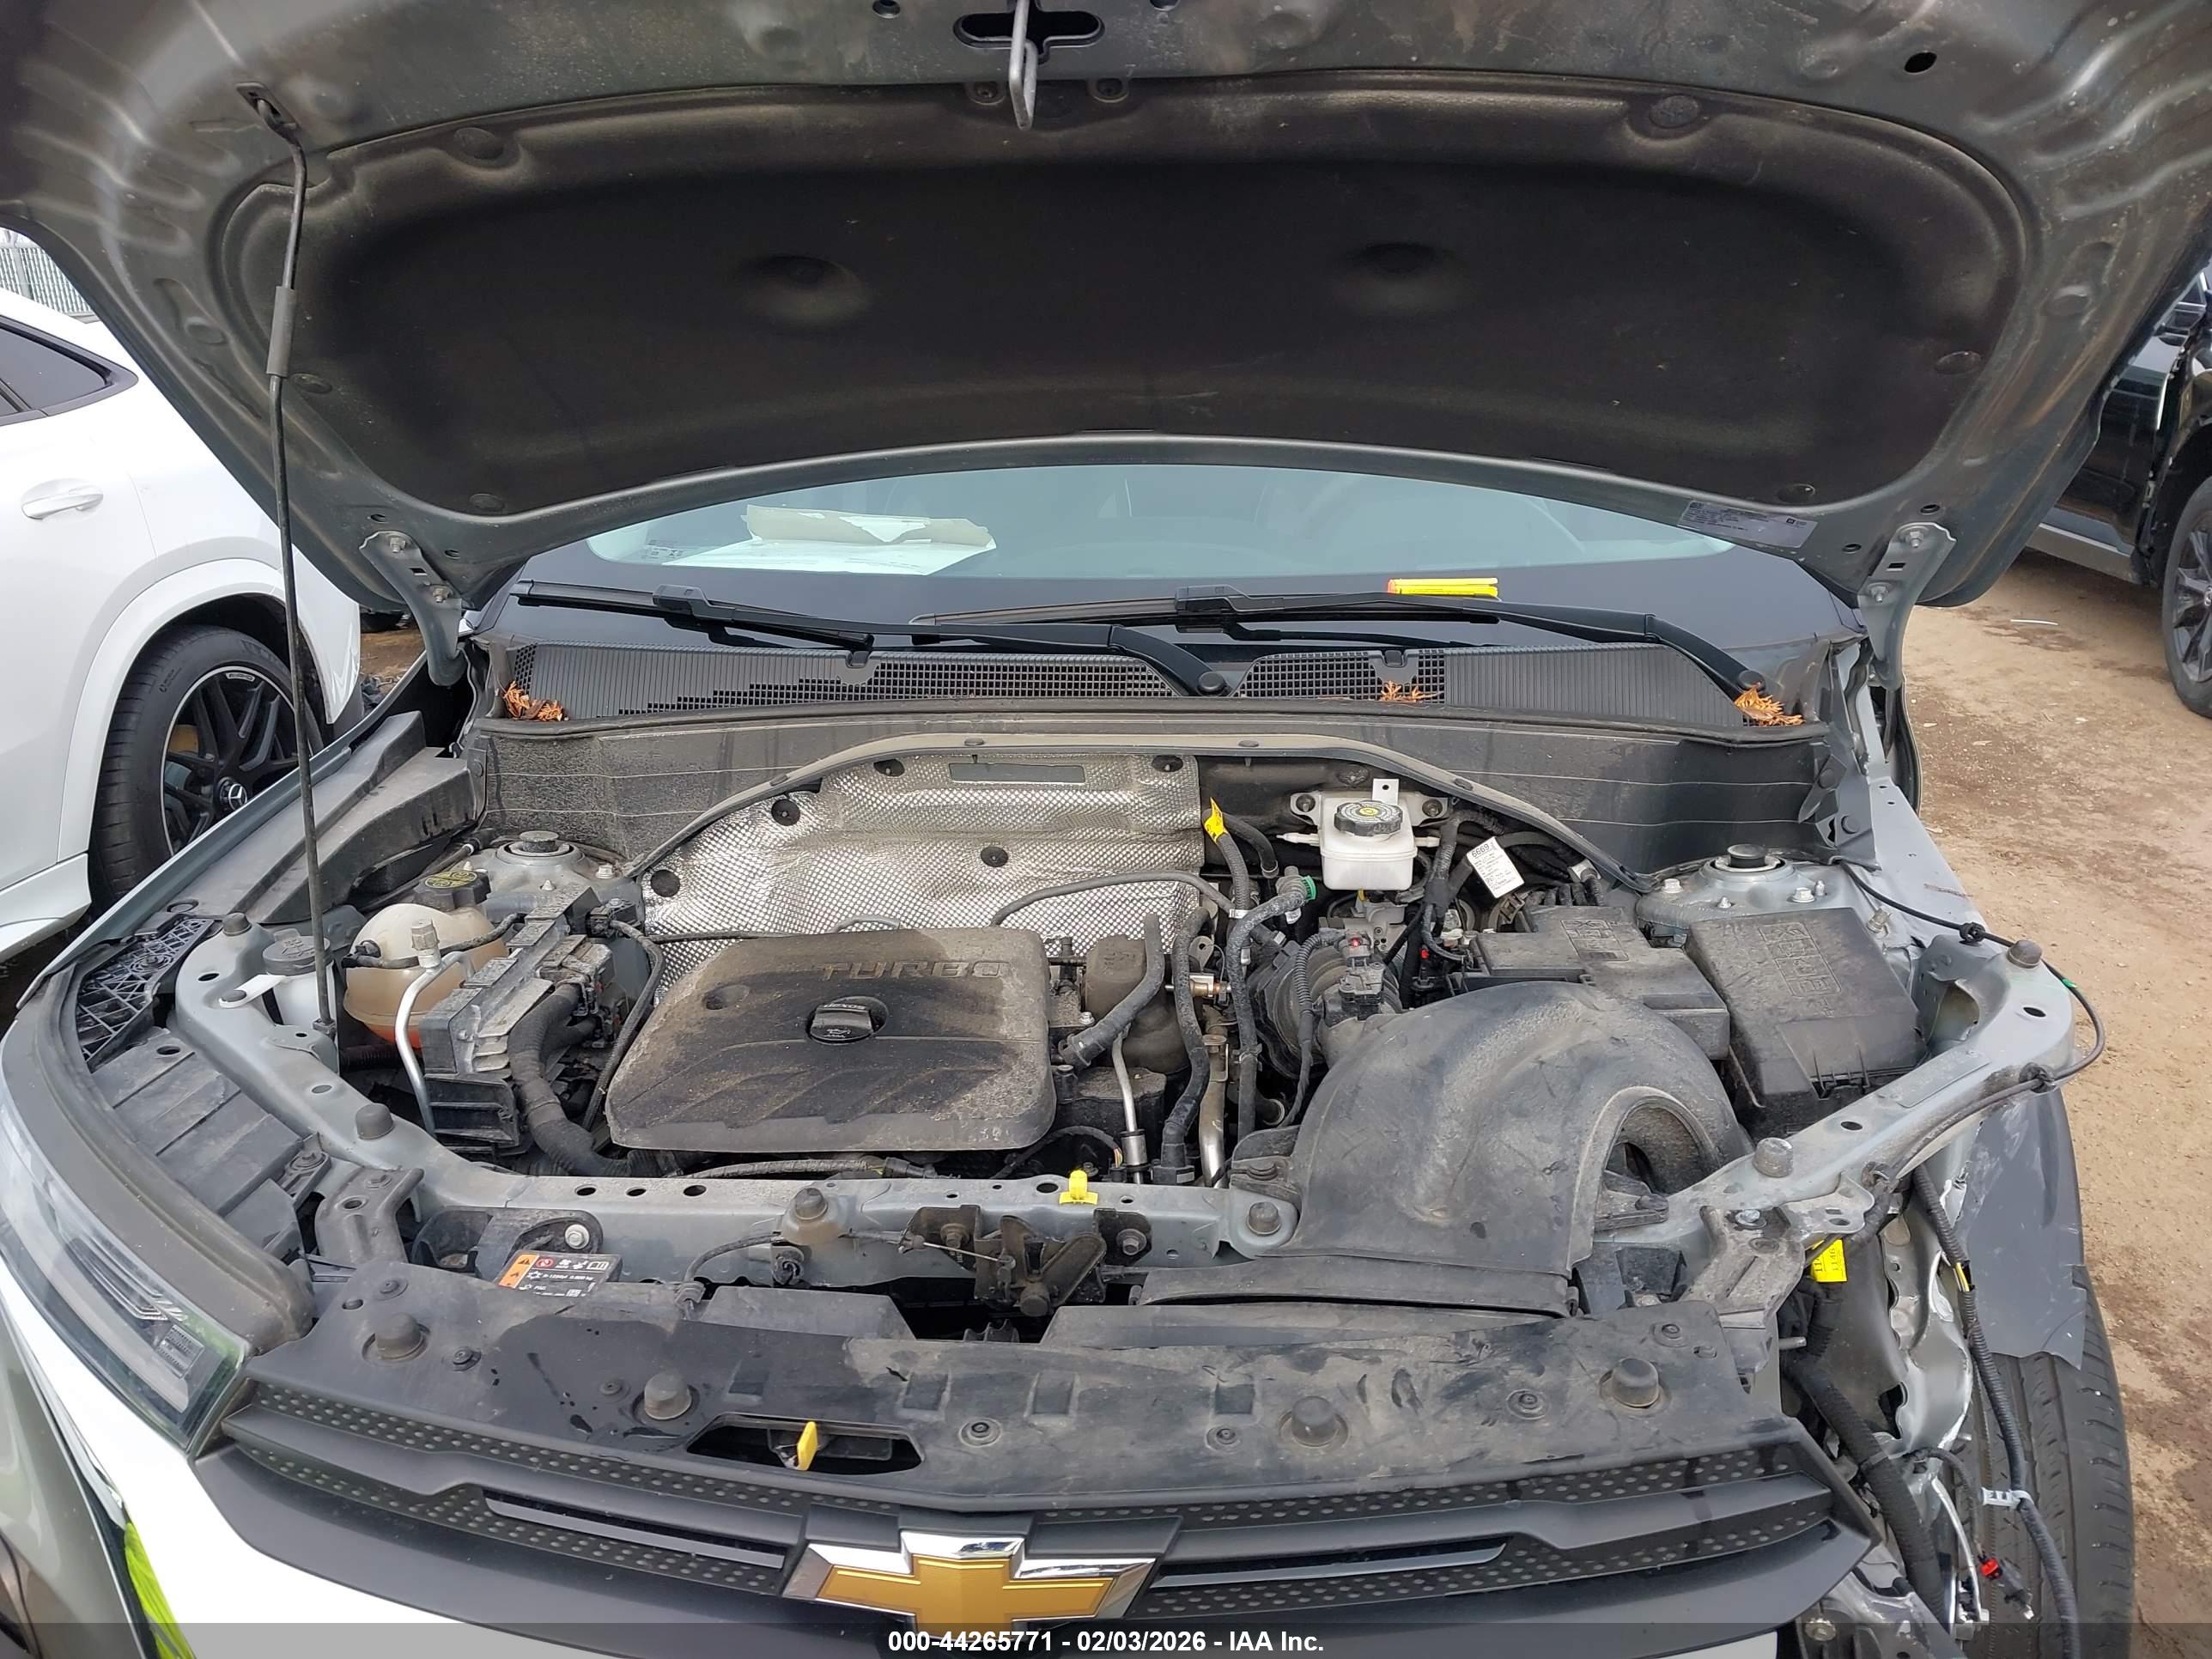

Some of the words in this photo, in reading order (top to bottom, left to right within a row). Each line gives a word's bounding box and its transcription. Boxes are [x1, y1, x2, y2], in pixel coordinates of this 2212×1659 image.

[1472, 843, 1490, 857] 6669
[817, 961, 1011, 981] TURBO
[823, 1002, 867, 1011] dexos
